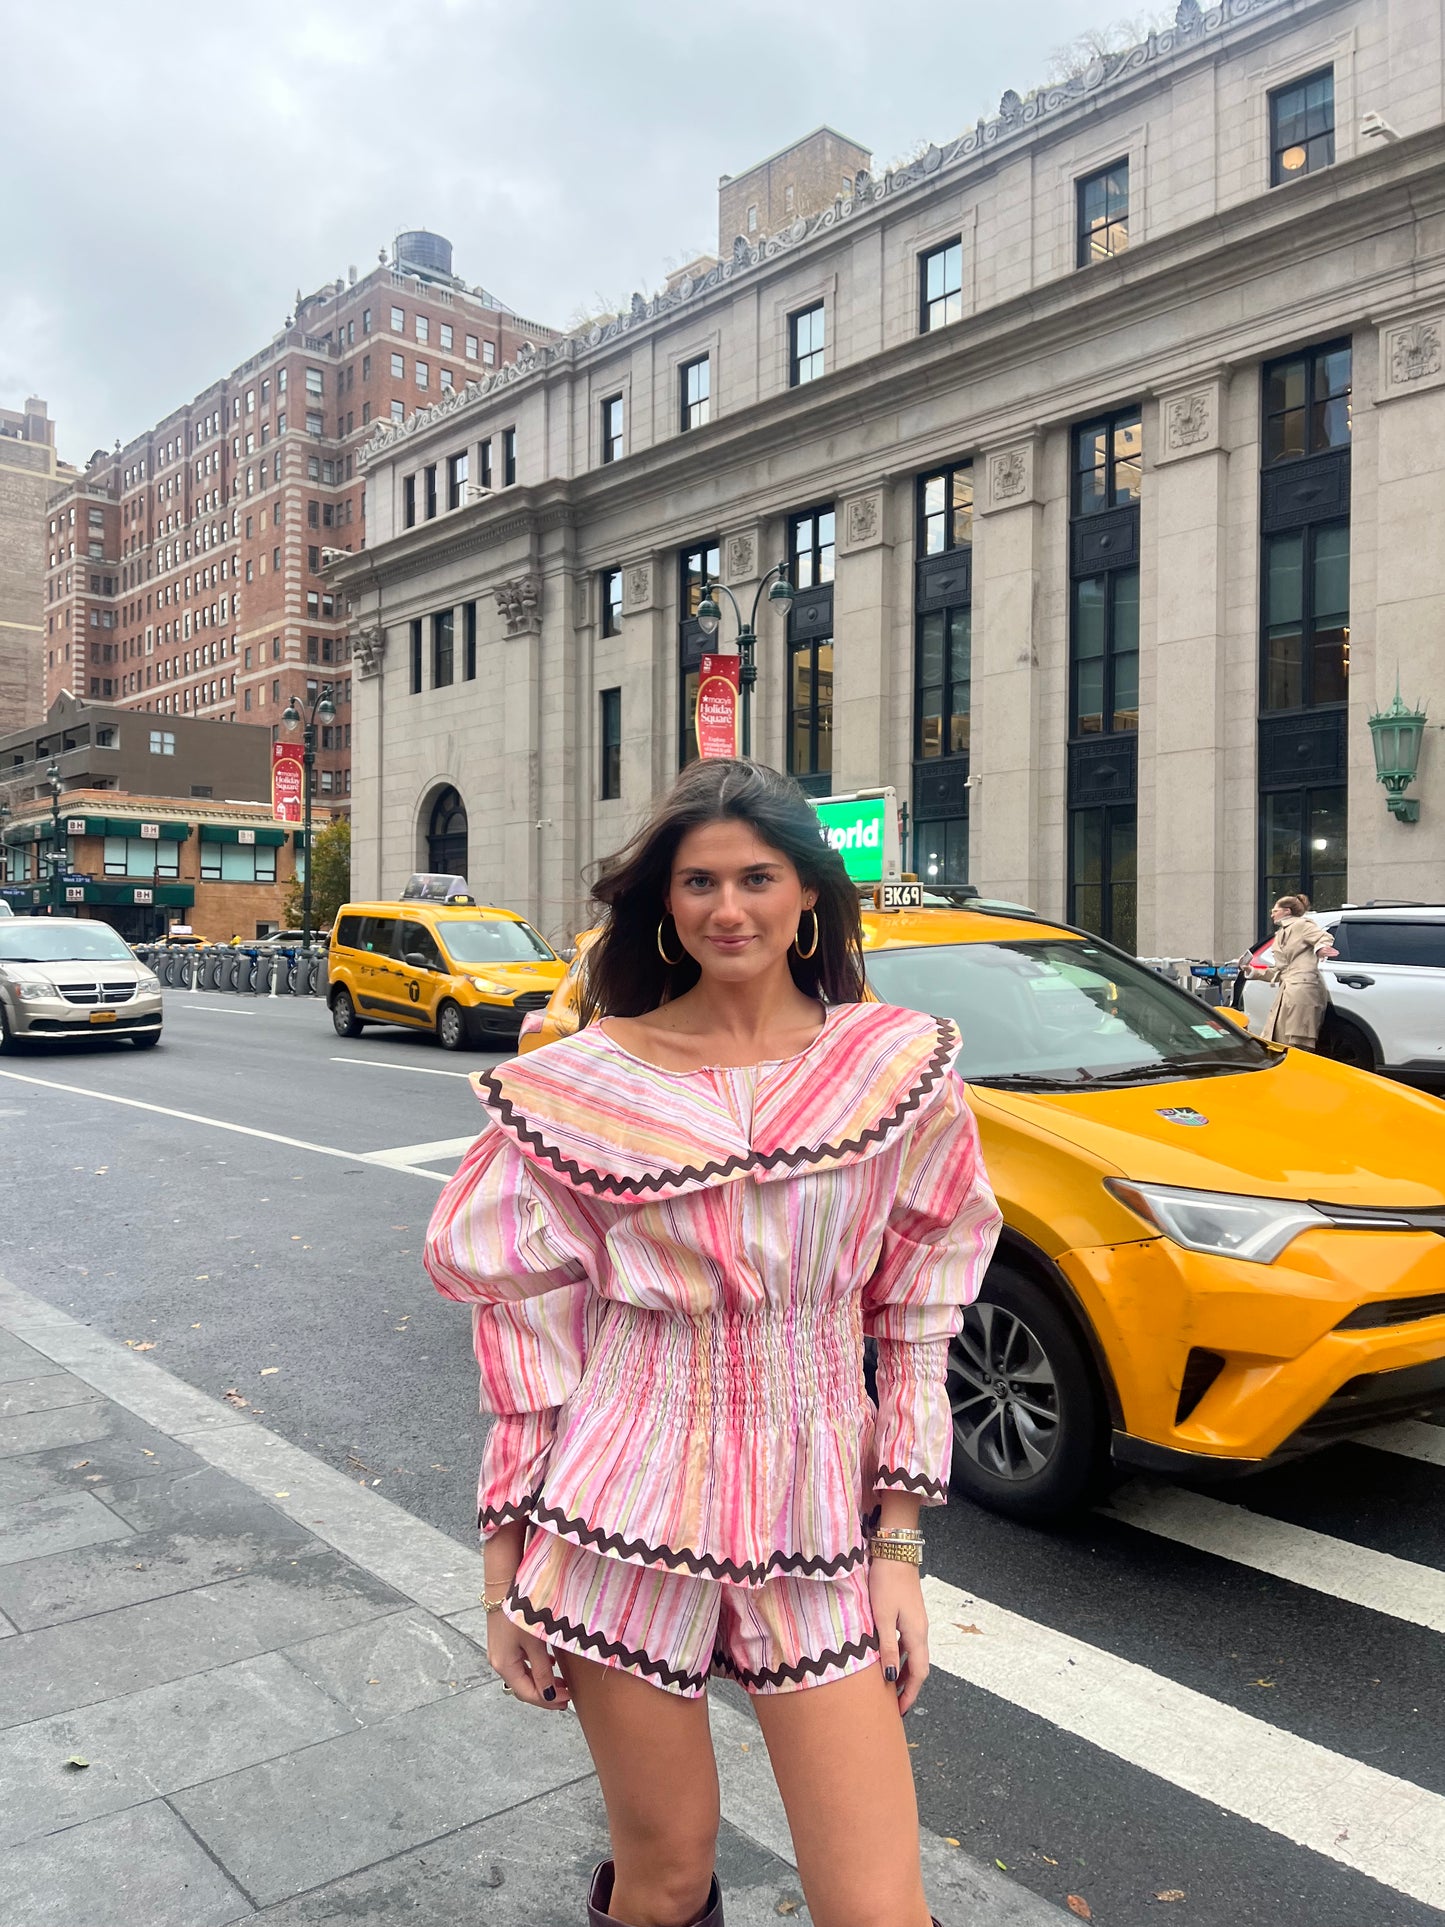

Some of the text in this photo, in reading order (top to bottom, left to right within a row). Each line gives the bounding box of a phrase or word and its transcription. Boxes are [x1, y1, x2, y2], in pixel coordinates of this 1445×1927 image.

[700, 703, 732, 716] Holiday
[700, 713, 732, 724] Square
[276, 776, 299, 785] Holiday
[884, 887, 919, 905] 3K69
